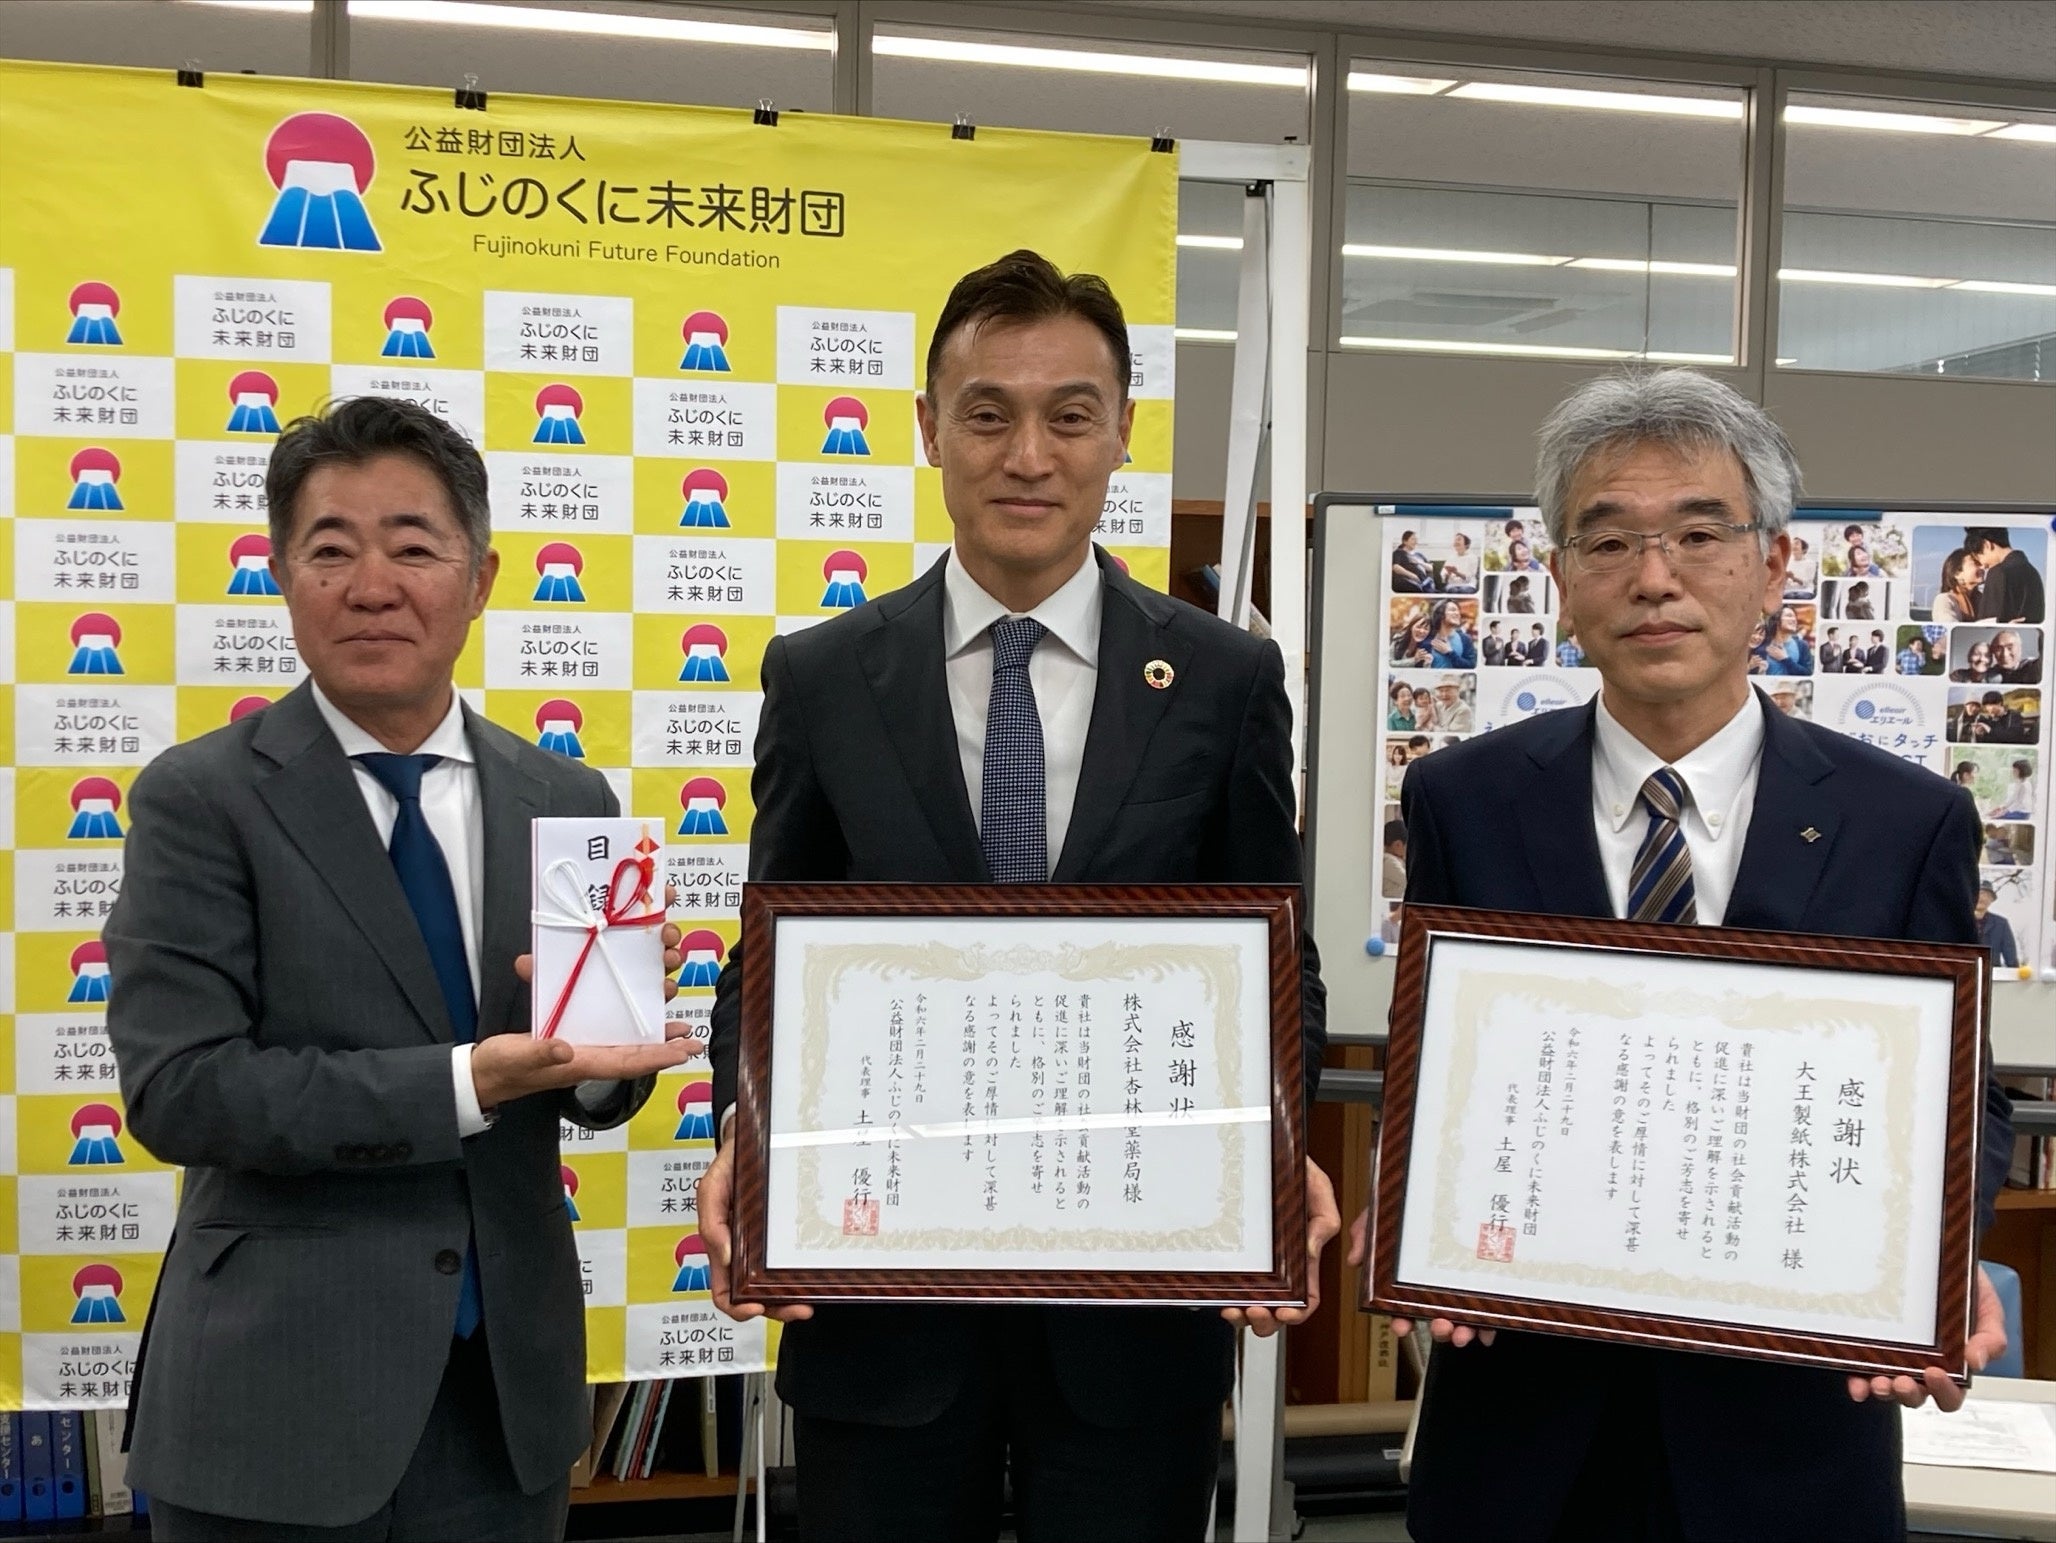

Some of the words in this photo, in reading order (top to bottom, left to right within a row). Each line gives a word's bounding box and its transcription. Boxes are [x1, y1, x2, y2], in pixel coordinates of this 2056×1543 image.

[404, 126, 586, 161] 公益財団法人
[400, 168, 845, 237] ふじのくに未来財団
[473, 234, 580, 258] Fujinokuni
[589, 240, 658, 262] Future
[666, 245, 780, 268] Foundation
[214, 291, 277, 303] 公益財団法人
[212, 307, 295, 326] ふじのくに
[521, 306, 582, 318] 公益財団法人
[520, 321, 598, 341] ふじのくに
[811, 320, 868, 333] 公益財団法人
[212, 330, 295, 349] 未来財団
[810, 336, 883, 355] ふじのくに
[520, 343, 599, 363] 未来財団
[55, 367, 120, 379] 公益財団法人
[810, 356, 883, 376] 未来財団
[52, 384, 138, 402] ふじのくに
[669, 392, 728, 404] 公益財団法人
[53, 406, 138, 425] 未来財団
[667, 408, 743, 426] ふじのくに
[667, 428, 744, 448] 未来財団
[522, 465, 582, 477] 公益財団法人
[520, 481, 599, 499] ふじのくに
[810, 476, 867, 487] 公益財団法人
[809, 491, 883, 508] ふじのくに
[520, 502, 599, 521] 未来財団
[809, 511, 883, 529] 未来財団
[55, 533, 121, 544] 公益財団法人
[53, 549, 139, 567] ふじのくに
[669, 549, 727, 560] 公益財団法人
[53, 572, 139, 590] 未来財団
[667, 564, 743, 581] ふじのくに
[667, 584, 743, 602] 未来財団
[214, 618, 279, 629] 公益財団法人
[521, 624, 582, 634] 公益財団法人
[213, 634, 297, 651] ふじのくに
[520, 639, 599, 656] ふじのくに
[213, 656, 297, 674] 未来財団
[520, 660, 599, 677] 未来財団
[55, 698, 121, 709] 公益財団法人
[668, 703, 726, 714] 公益財団法人
[53, 714, 139, 731] ふじのくに
[666, 719, 742, 735] ふじのくに
[1869, 716, 1913, 725] エリエール
[54, 736, 140, 754] 未来財団
[666, 738, 742, 756] 未来財団
[1850, 732, 1939, 749] おにタッチ
[667, 857, 725, 866] 公益財団法人
[666, 872, 741, 888] ふじのくに
[1009, 994, 1022, 1069] られました
[913, 992, 928, 1104] 令和六年二月二十九日
[859, 1055, 873, 1099] 代表理事
[1560, 1027, 1581, 1136] 令和六年二月二十九日
[1662, 1036, 1679, 1112] られました
[1505, 1083, 1520, 1126] 代表理事
[1605, 1032, 1632, 1200] なる感謝の意を表します
[1523, 1030, 1556, 1236] 公益財団法人ふじのくに未来財団
[1829, 1078, 1866, 1186] 感謝状
[1494, 1137, 1516, 1173] 土屋
[1701, 1040, 1730, 1261] 促進に深いご理解を示されると
[1724, 1042, 1755, 1262] 貴社は当財団の社会貢献活動の
[57, 1187, 120, 1199] 公益財団法人
[55, 1202, 139, 1220] ふじのくに
[56, 1223, 140, 1242] 未来財団
[661, 1312, 719, 1325] 公益財団法人
[659, 1326, 734, 1346] ふじのくに
[60, 1346, 122, 1355] 公益財団法人
[659, 1346, 734, 1367] 未来財団
